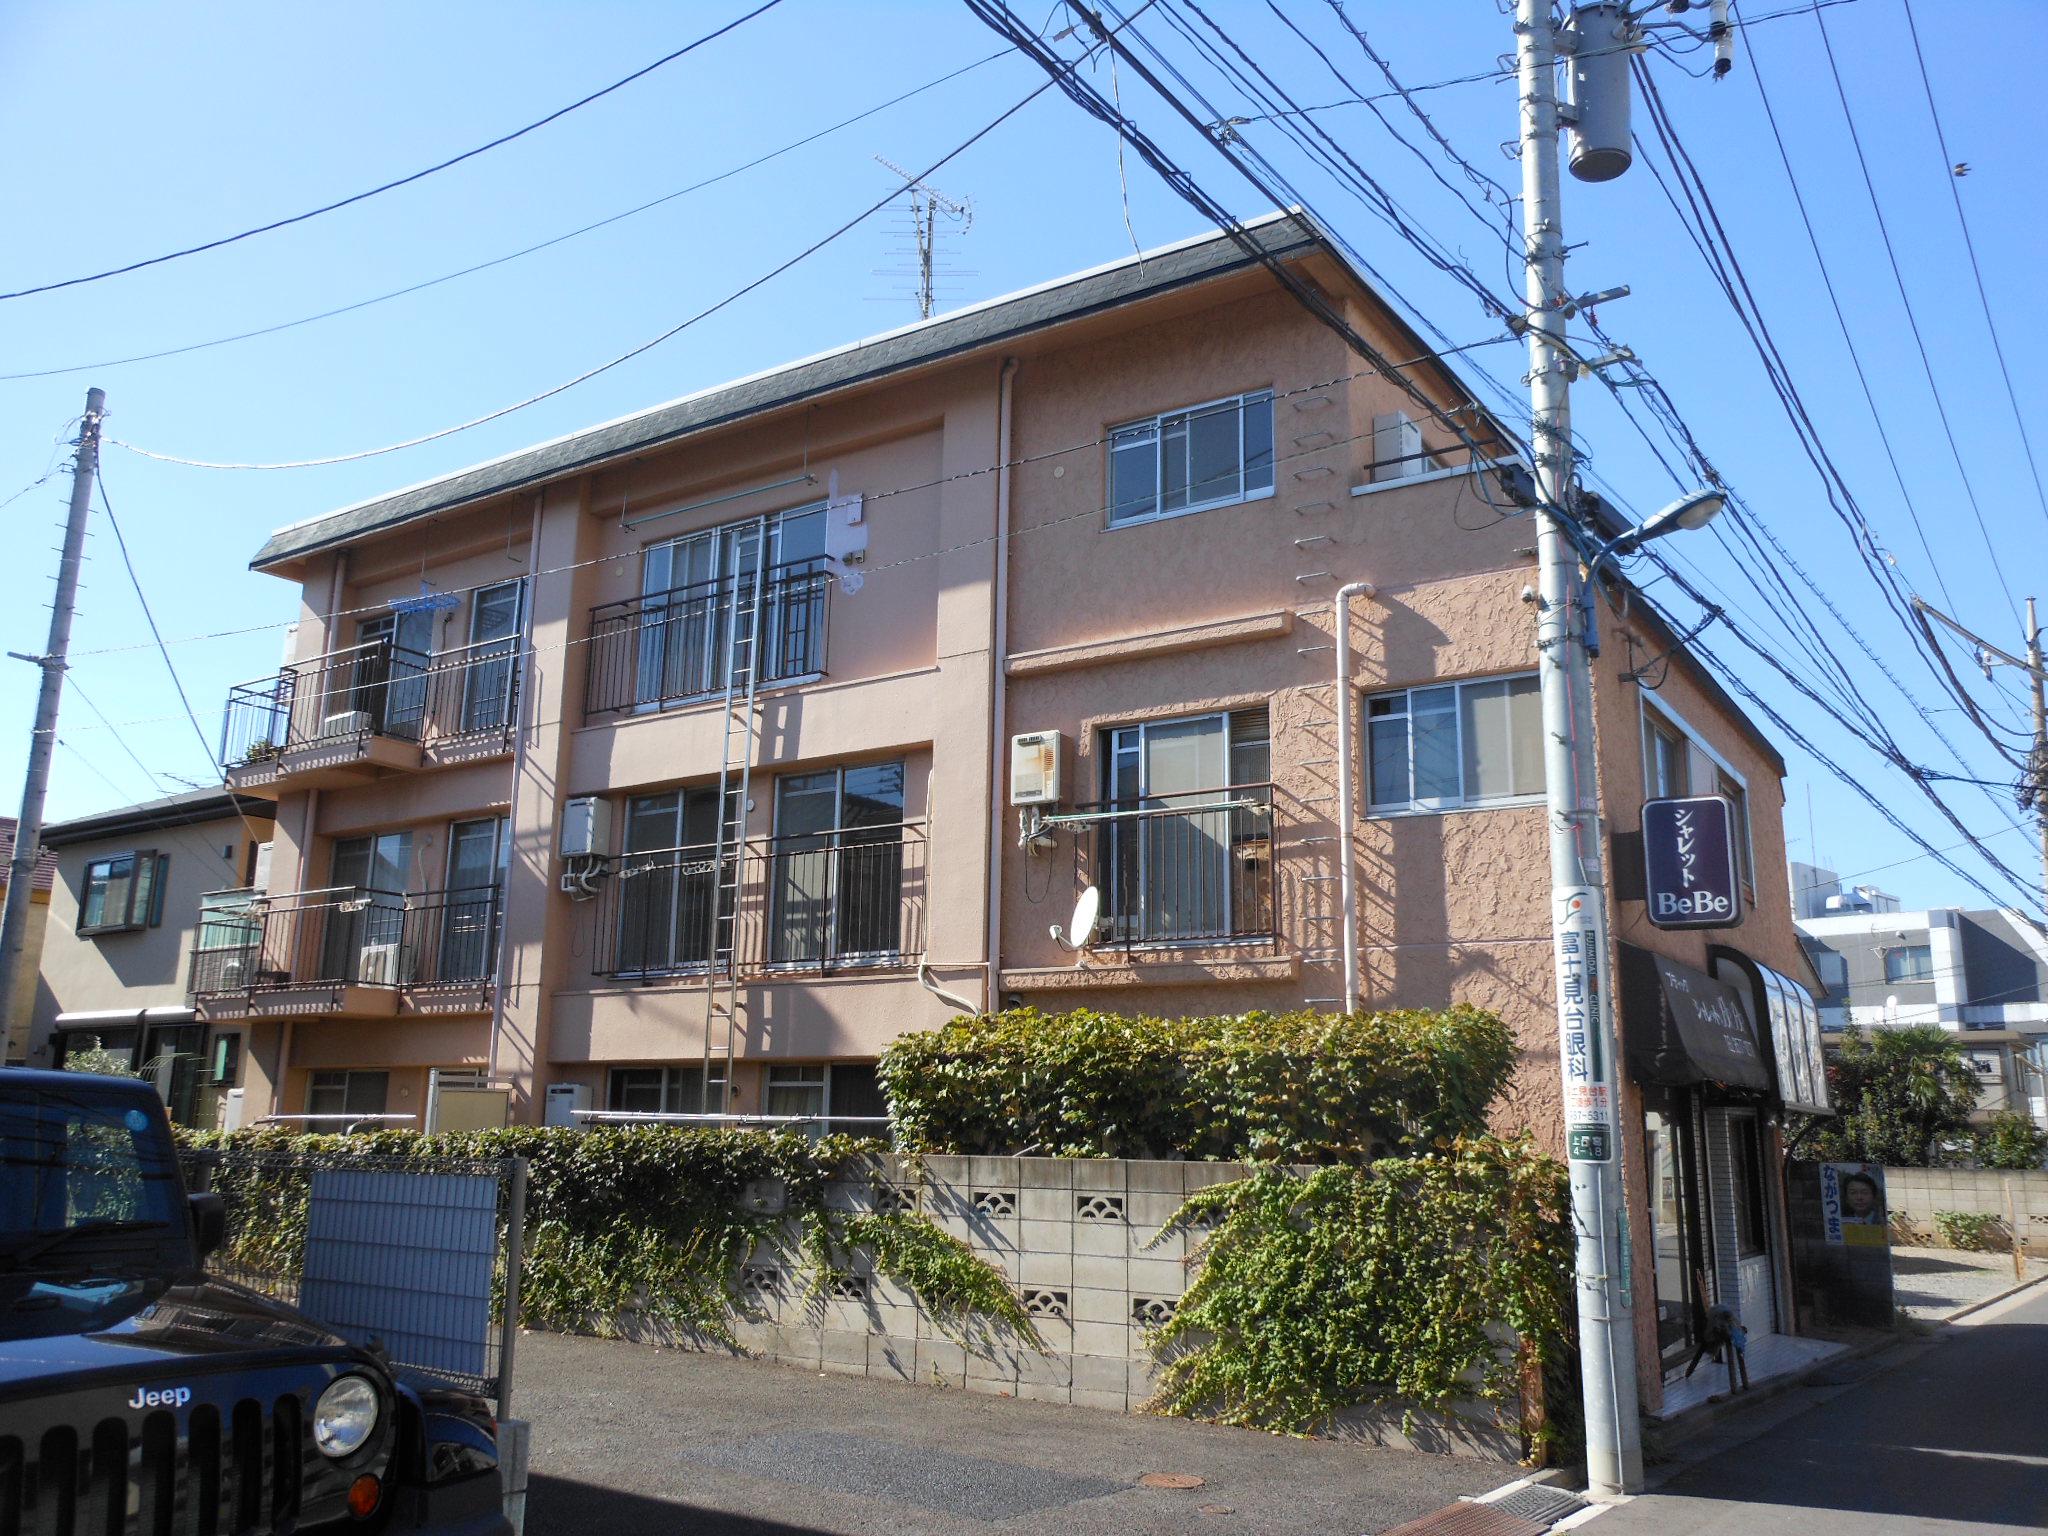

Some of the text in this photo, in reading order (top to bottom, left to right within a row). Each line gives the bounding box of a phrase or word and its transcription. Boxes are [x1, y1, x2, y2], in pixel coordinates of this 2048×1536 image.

[1674, 809, 1696, 888] シャレット
[1657, 890, 1729, 915] BeBe
[1561, 931, 1588, 1081] 富士見台眼科
[1823, 1164, 1841, 1234] ながつま
[128, 1387, 191, 1409] Jeep
